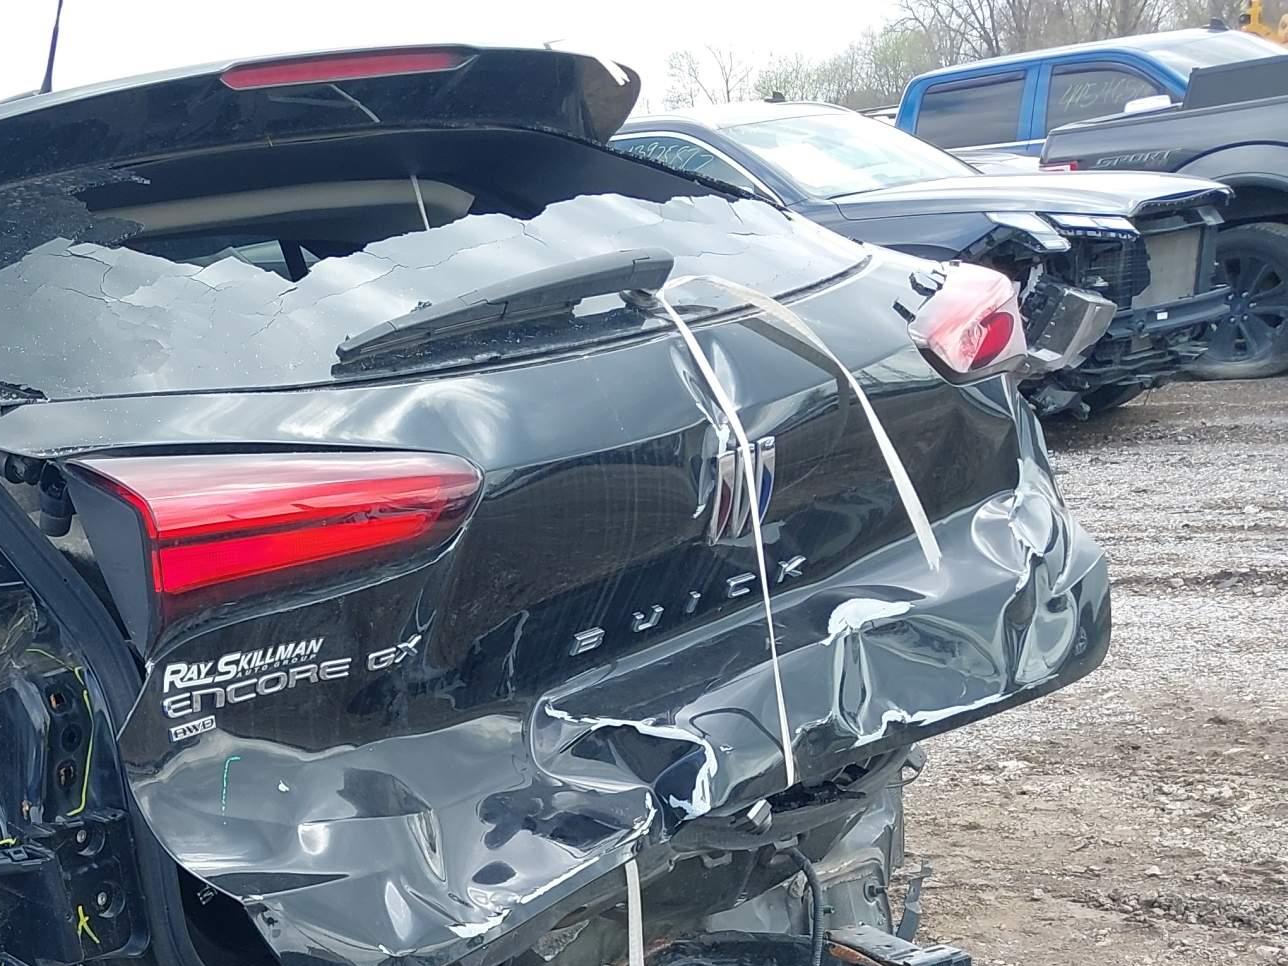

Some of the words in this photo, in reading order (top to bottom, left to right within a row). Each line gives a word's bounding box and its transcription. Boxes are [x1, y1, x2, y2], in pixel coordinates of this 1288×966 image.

[568, 554, 807, 657] BUICK
[163, 661, 213, 694] RAY
[214, 636, 324, 683] SKILLMAN
[163, 657, 352, 719] ENCORE
[366, 633, 422, 672] GX
[236, 665, 269, 679] AUTO
[273, 654, 317, 669] GROUP
[171, 716, 216, 740] AWD
